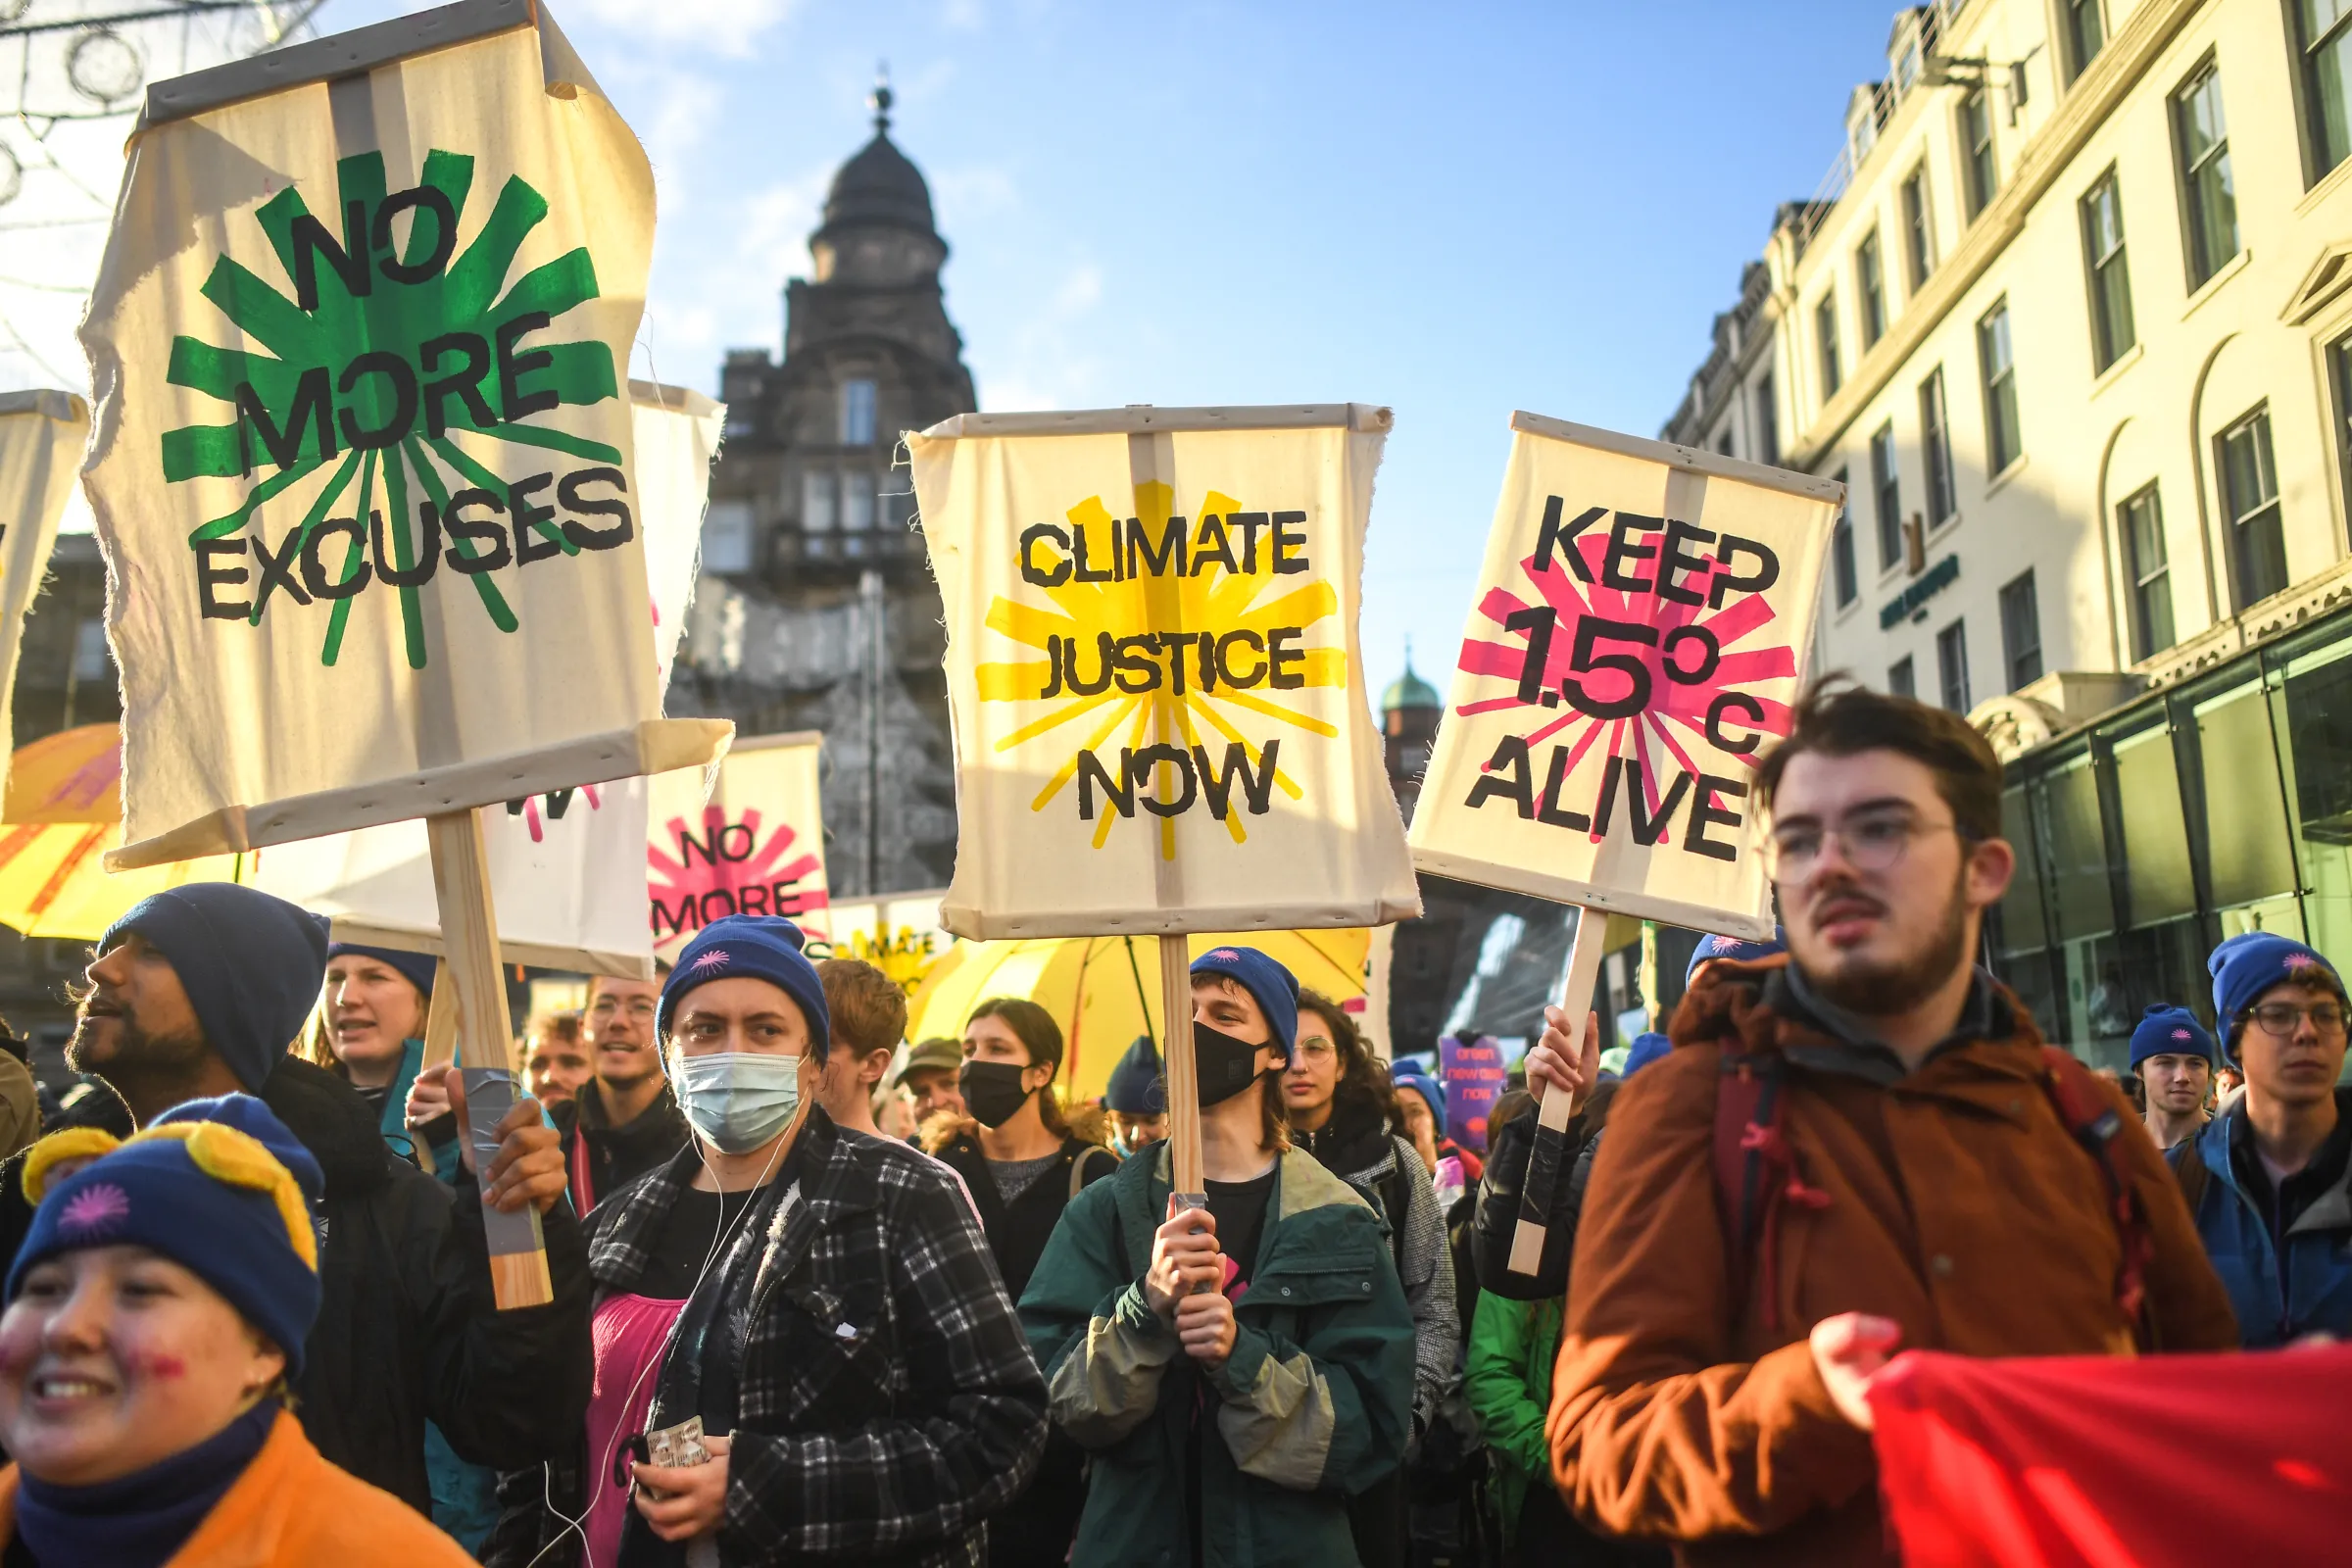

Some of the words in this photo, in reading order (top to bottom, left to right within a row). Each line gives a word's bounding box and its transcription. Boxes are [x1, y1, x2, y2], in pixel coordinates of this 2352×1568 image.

[290, 185, 458, 312] NO
[234, 311, 560, 480] MORE
[196, 467, 633, 619] EXCUSES
[1019, 511, 1310, 587] CLIMATE
[1533, 495, 1780, 610] KEEP
[1041, 627, 1305, 699] JUSTICE
[1077, 739, 1280, 820] NOW
[1464, 734, 1748, 861] ALIVE
[680, 824, 754, 868] NO
[651, 880, 803, 936] MORE
